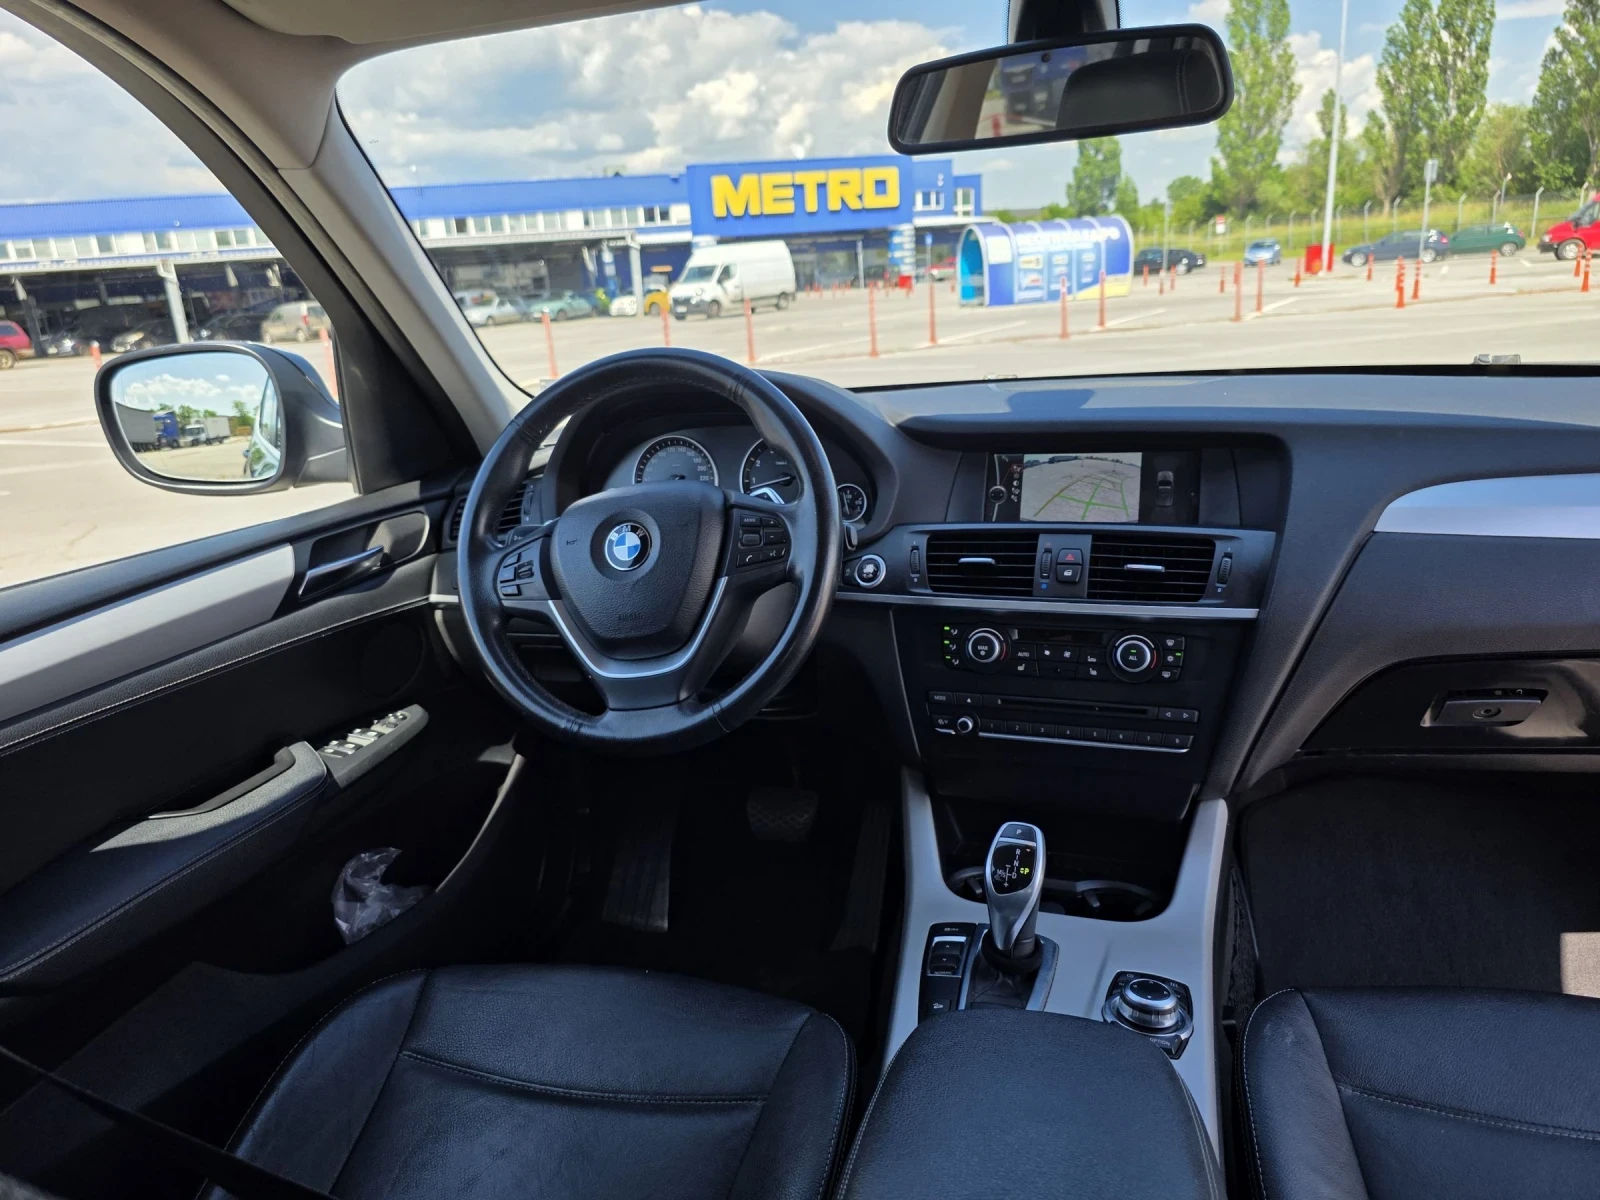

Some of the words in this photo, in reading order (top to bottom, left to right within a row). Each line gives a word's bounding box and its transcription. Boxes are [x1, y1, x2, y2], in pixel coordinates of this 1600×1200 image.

[710, 166, 900, 217] METRO
[610, 525, 646, 541] BMW
[1149, 1037, 1171, 1046] OPTION
